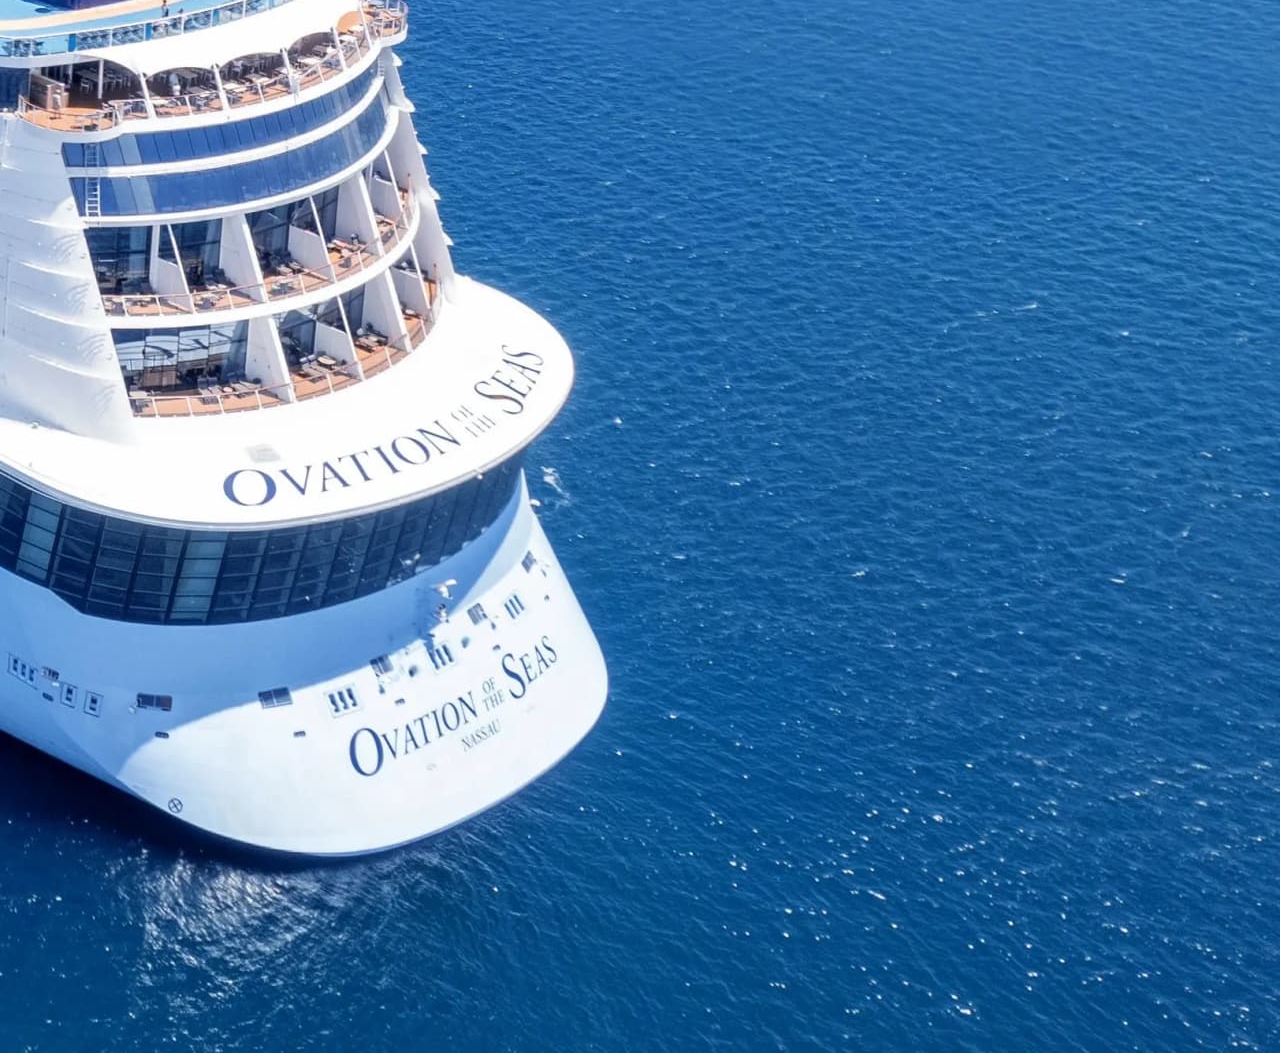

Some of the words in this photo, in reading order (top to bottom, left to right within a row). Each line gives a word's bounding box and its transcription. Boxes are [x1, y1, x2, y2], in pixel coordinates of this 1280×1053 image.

[223, 420, 461, 506] OVATION
[474, 344, 544, 415] SEAS
[349, 691, 478, 777] OVATION
[501, 635, 558, 699] SEAS
